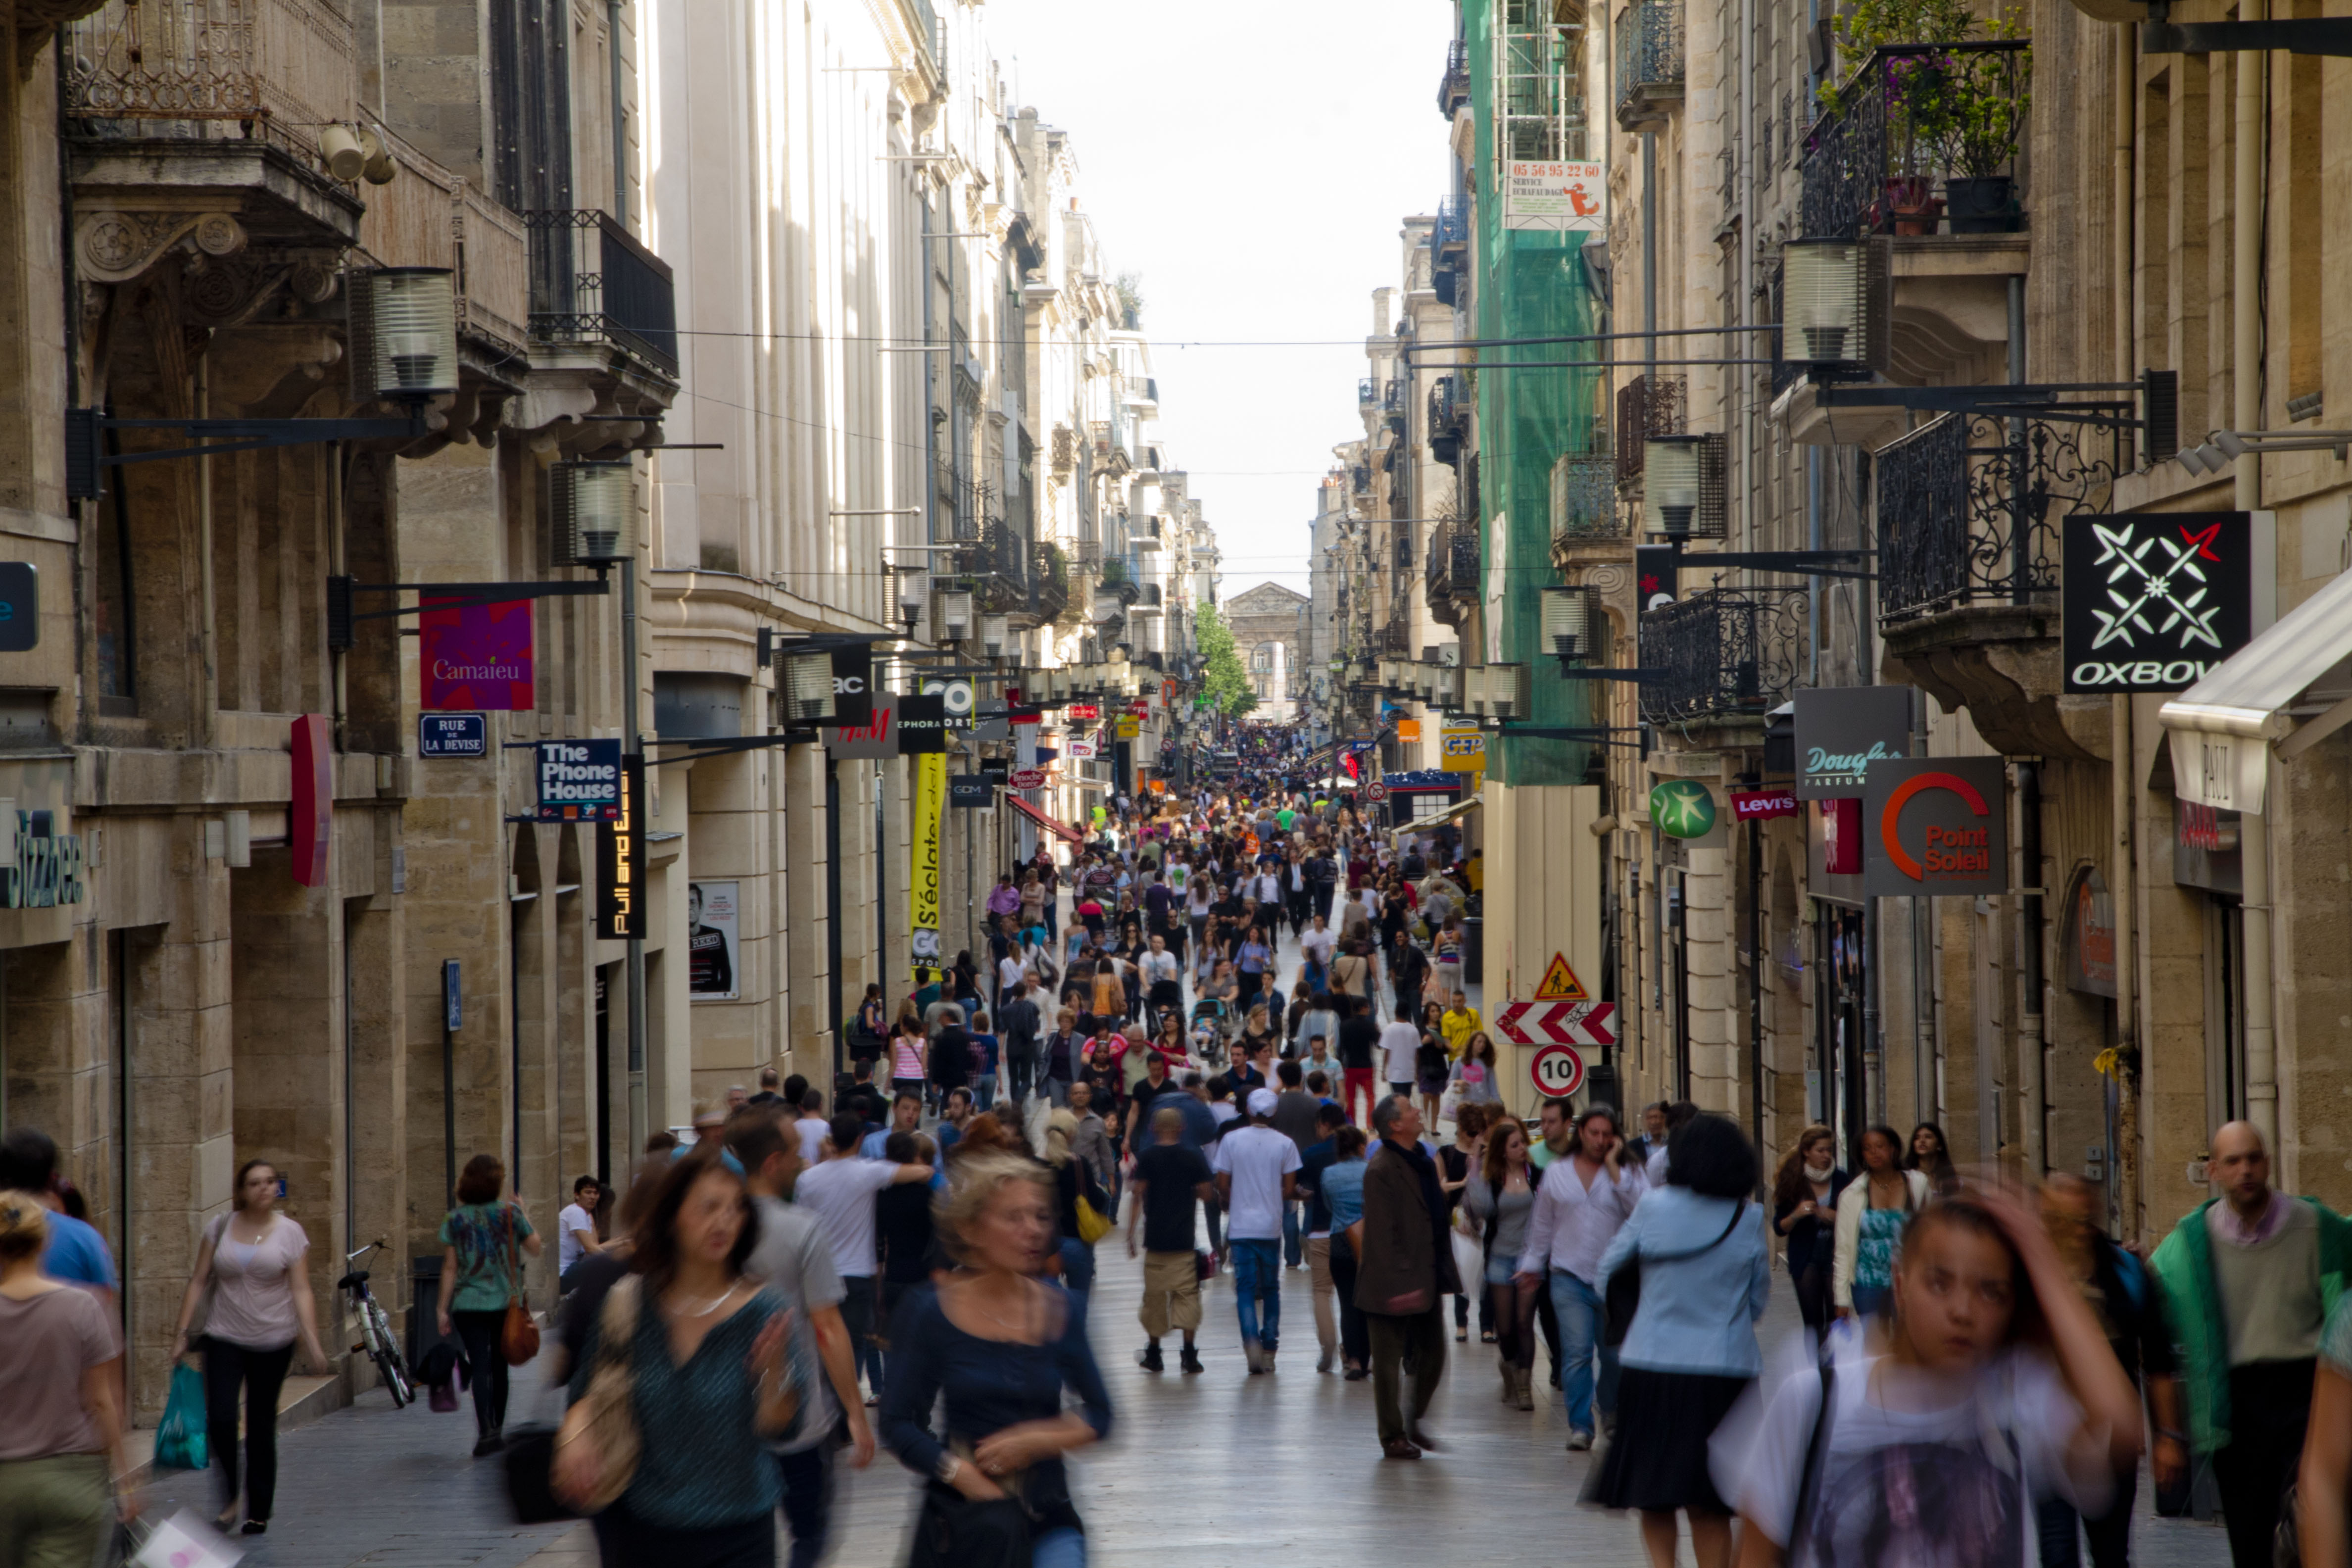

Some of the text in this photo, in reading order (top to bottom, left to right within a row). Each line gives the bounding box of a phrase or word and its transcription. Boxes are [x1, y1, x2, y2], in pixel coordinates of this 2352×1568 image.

[1514, 164, 1599, 177] 05 56 95 22 60
[1513, 178, 1542, 186] SERVICE
[1512, 188, 1564, 196] ECHAFAUDAGE
[439, 720, 466, 731] RUE
[944, 718, 972, 727] ORT
[425, 739, 481, 750] LA DEVISE
[542, 743, 589, 762] The
[542, 762, 616, 781] Phone
[1014, 772, 1042, 782] Brioche
[542, 781, 616, 800] House
[1926, 825, 1988, 847] Point
[615, 835, 630, 883] and
[1924, 849, 1989, 872] Soleil
[918, 812, 937, 925] S'éclater
[614, 888, 630, 934] Pull
[691, 934, 718, 948] REED
[911, 958, 939, 967] SPO
[1542, 1060, 1572, 1079] 10
